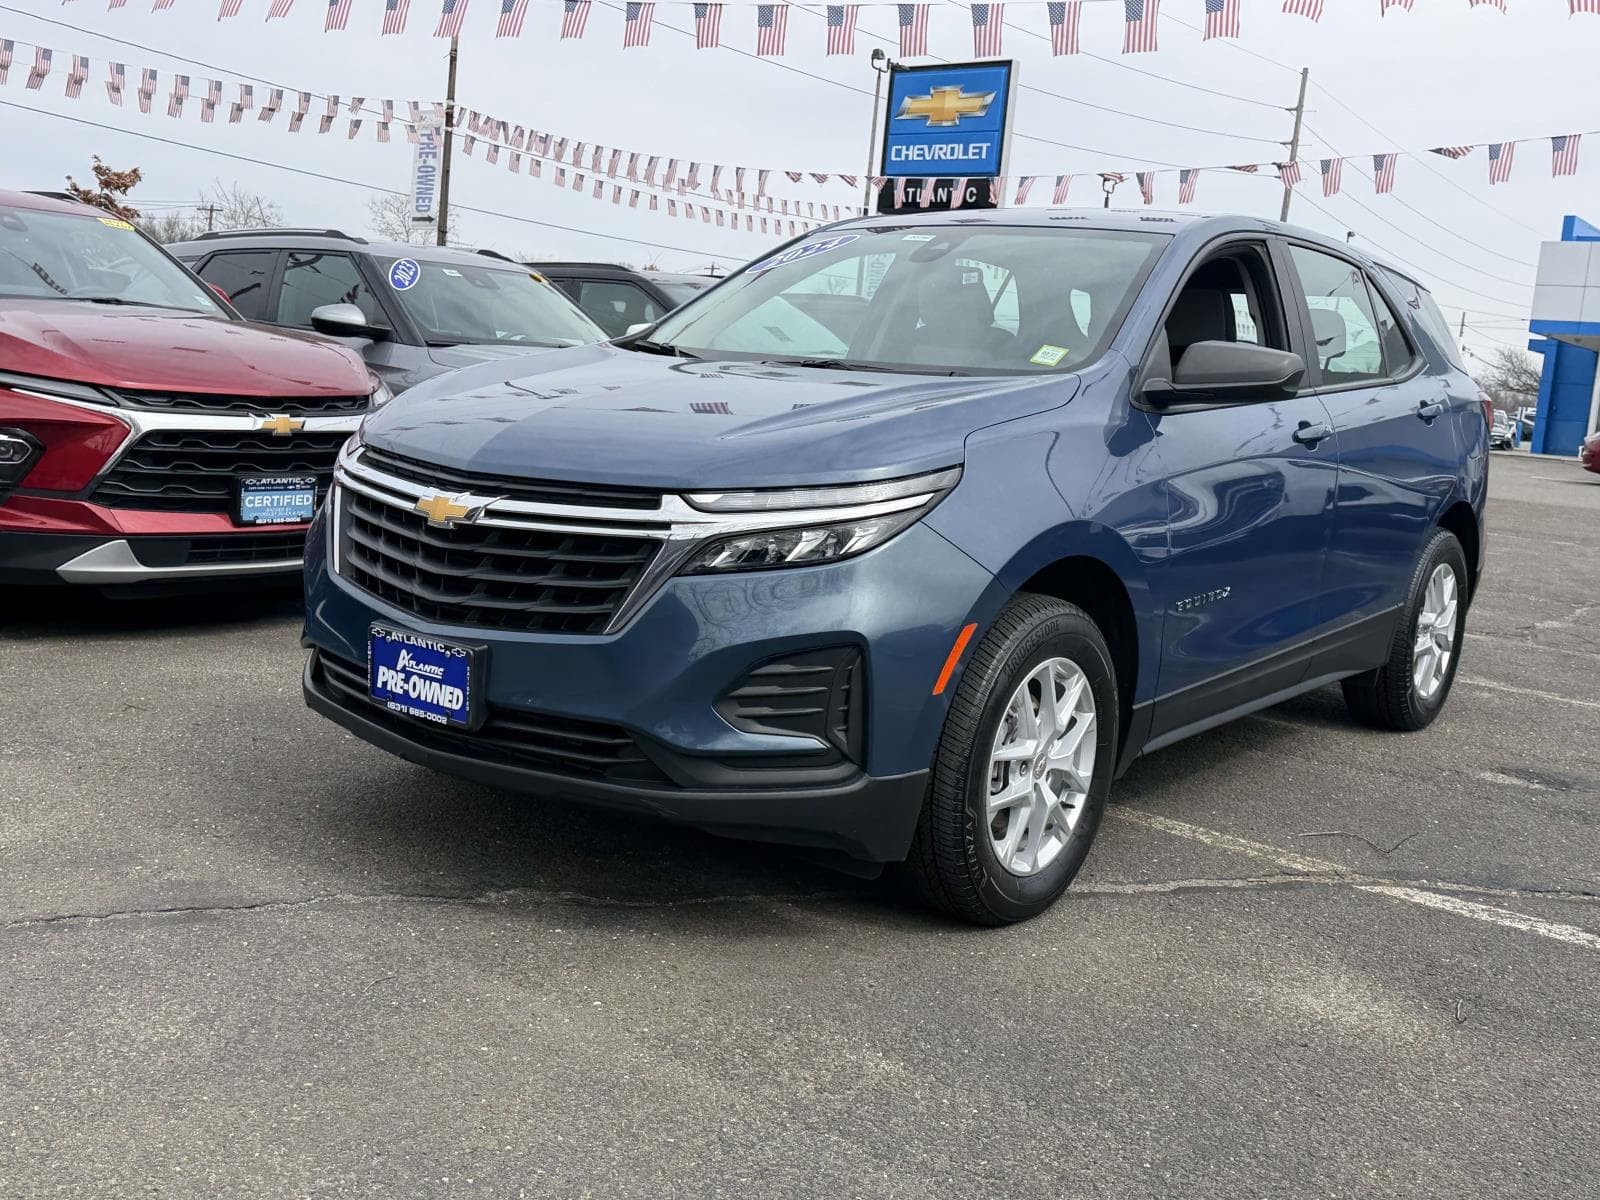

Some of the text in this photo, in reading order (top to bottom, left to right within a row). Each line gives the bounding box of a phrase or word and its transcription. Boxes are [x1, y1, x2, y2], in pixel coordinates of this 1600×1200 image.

[890, 142, 991, 161] CHEVROLET
[764, 237, 843, 268] 2024
[394, 261, 415, 286] 2023
[245, 494, 312, 507] CERTIFIED
[391, 632, 445, 653] ATLANTIC
[396, 649, 445, 675] ATLANTIC
[377, 665, 464, 711] PRE-OWNED
